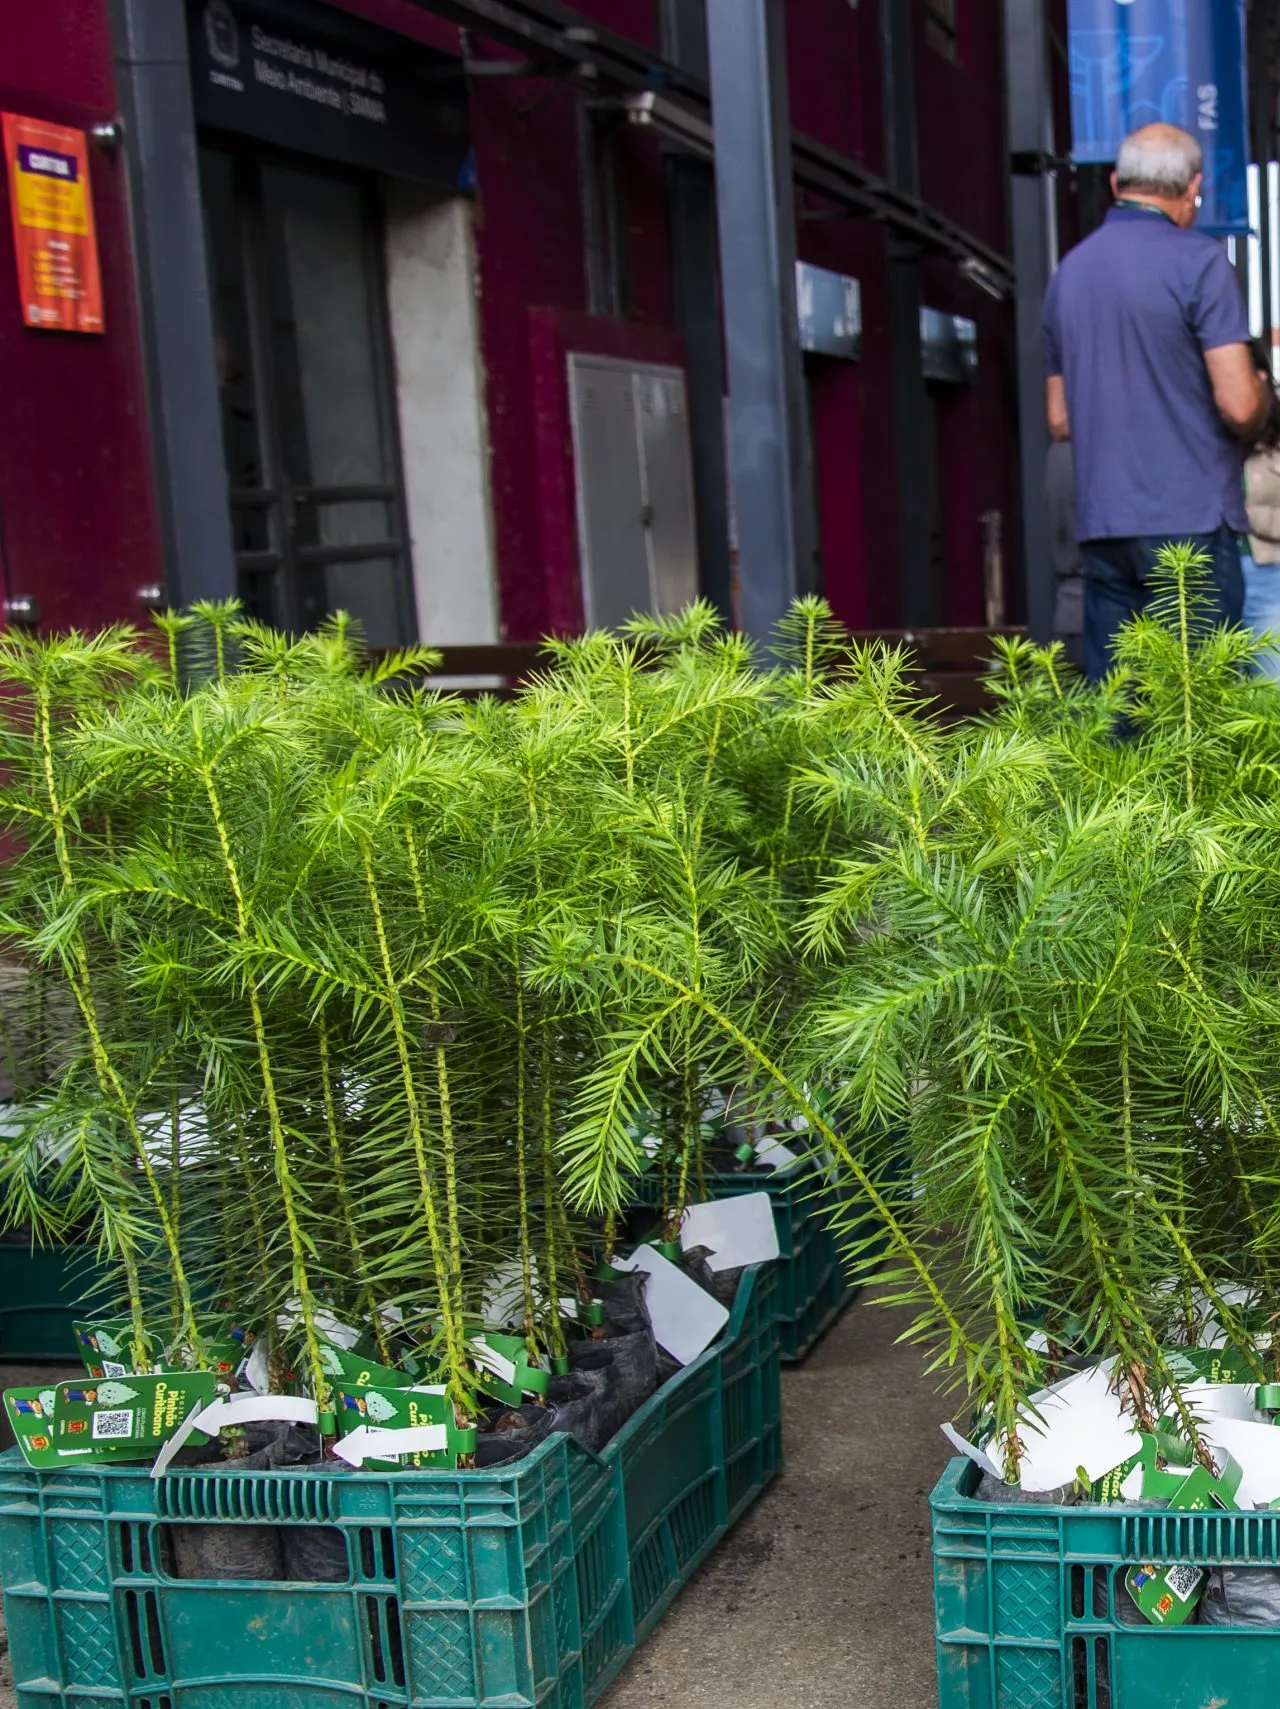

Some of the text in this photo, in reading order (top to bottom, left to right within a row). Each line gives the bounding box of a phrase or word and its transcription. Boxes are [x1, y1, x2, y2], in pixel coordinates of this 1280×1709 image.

[1197, 83, 1218, 130] FAS
[152, 1382, 167, 1437] Curitibano
[166, 1391, 178, 1428] Pinhão
